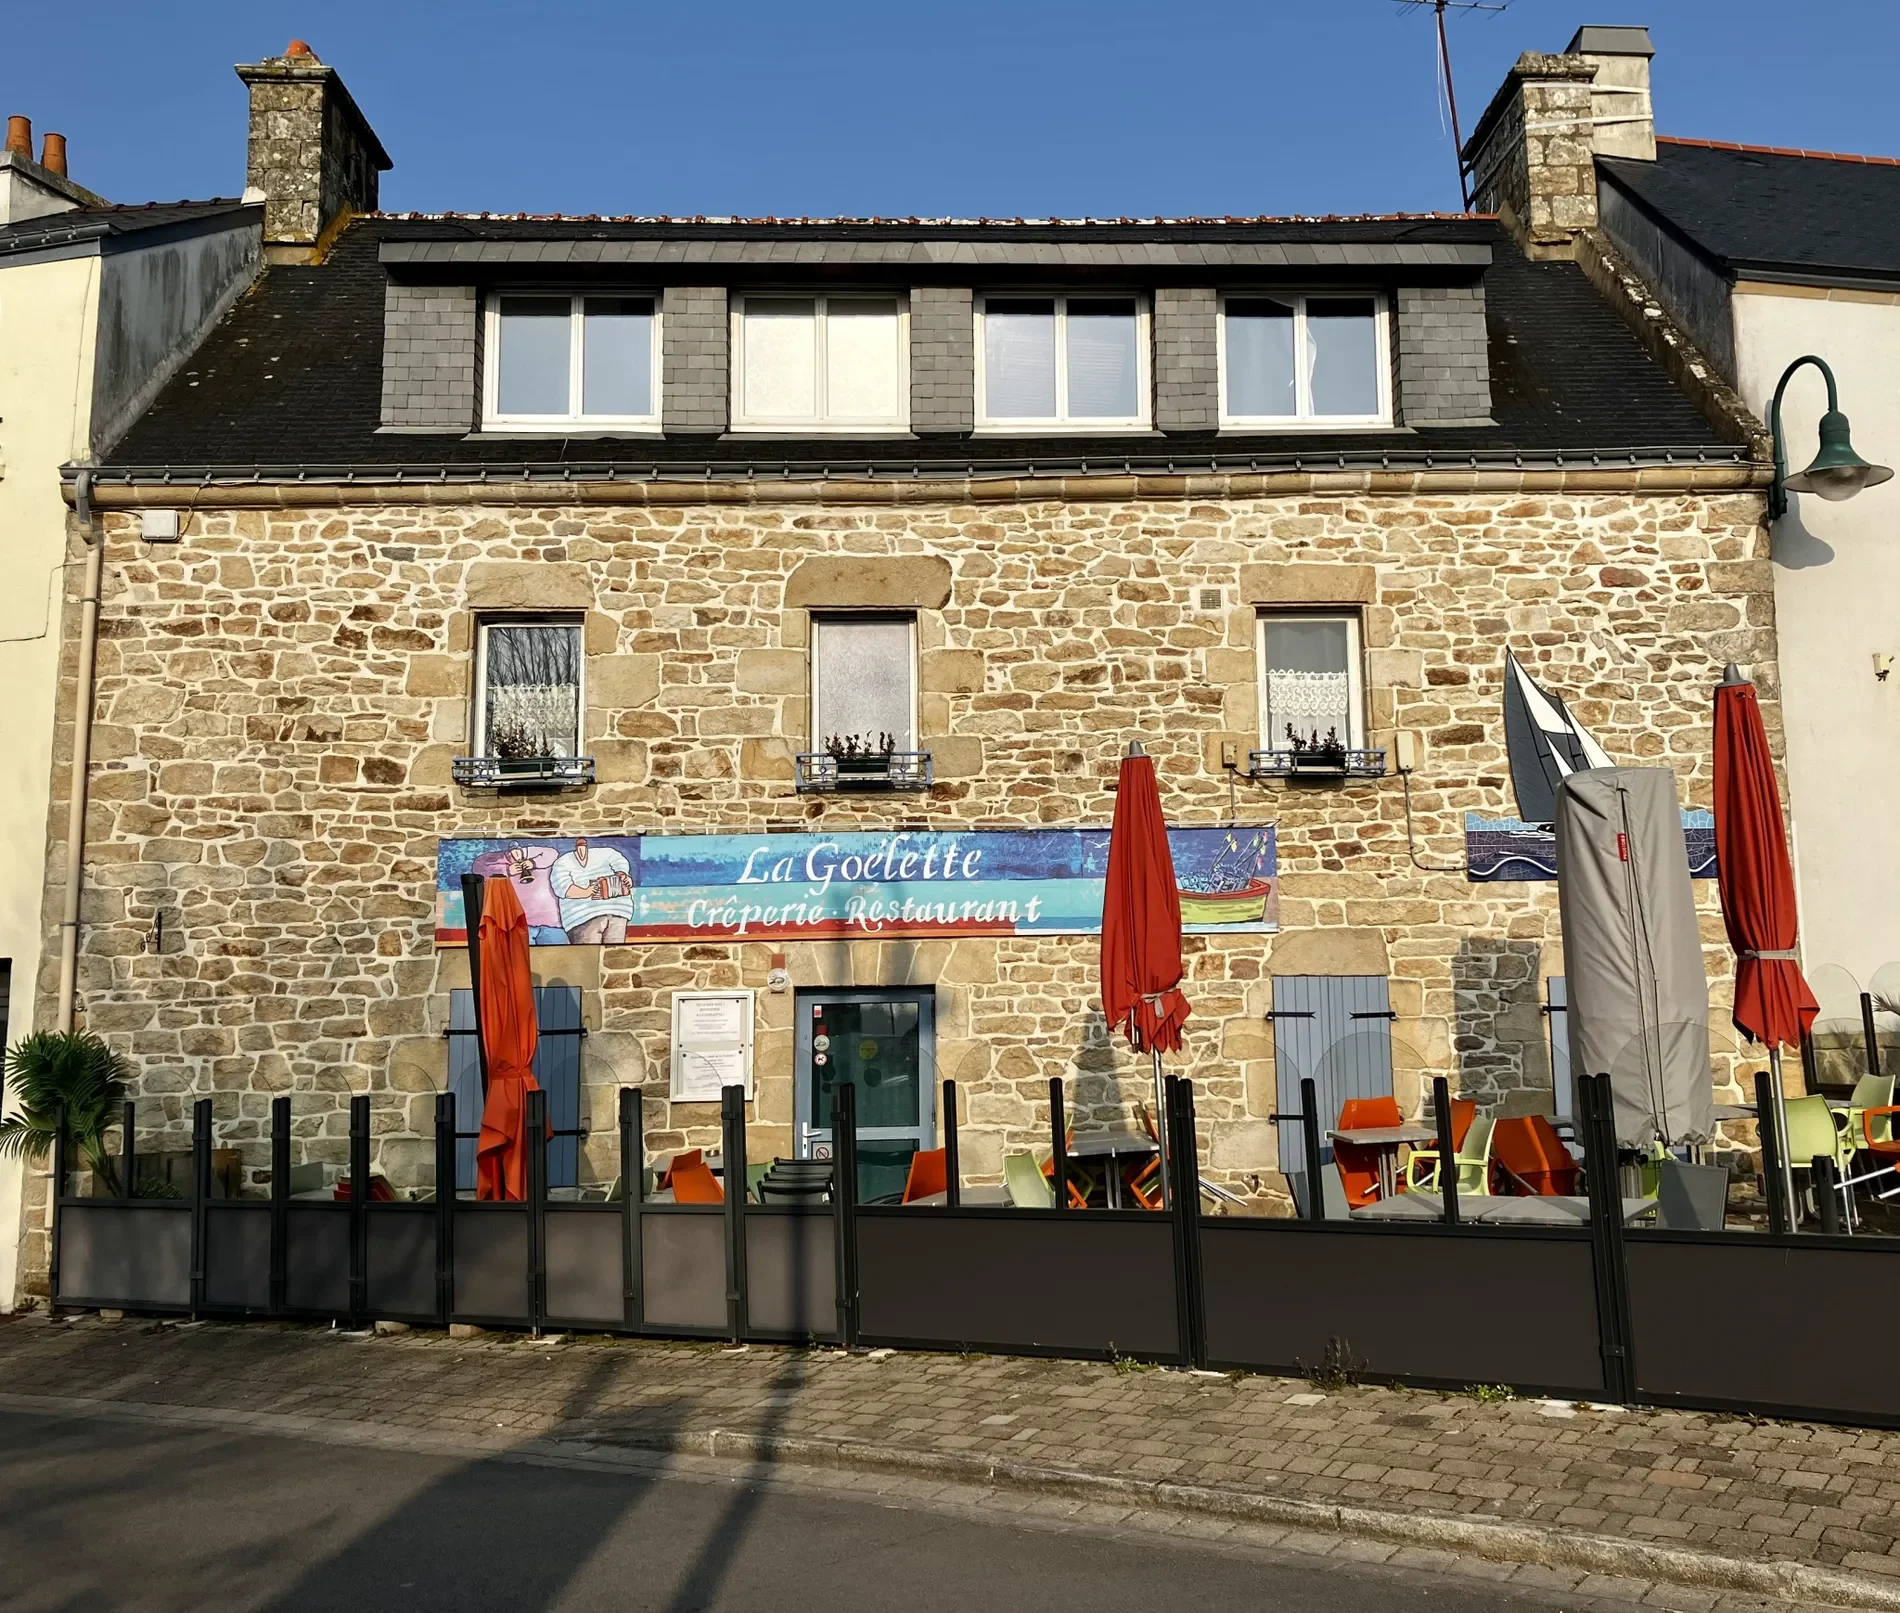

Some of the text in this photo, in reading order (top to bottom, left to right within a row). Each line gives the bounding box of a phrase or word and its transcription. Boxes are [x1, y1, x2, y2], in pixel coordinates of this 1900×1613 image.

[737, 834, 982, 896] La Goélette
[687, 893, 1043, 936] Crêperie Restaurant
